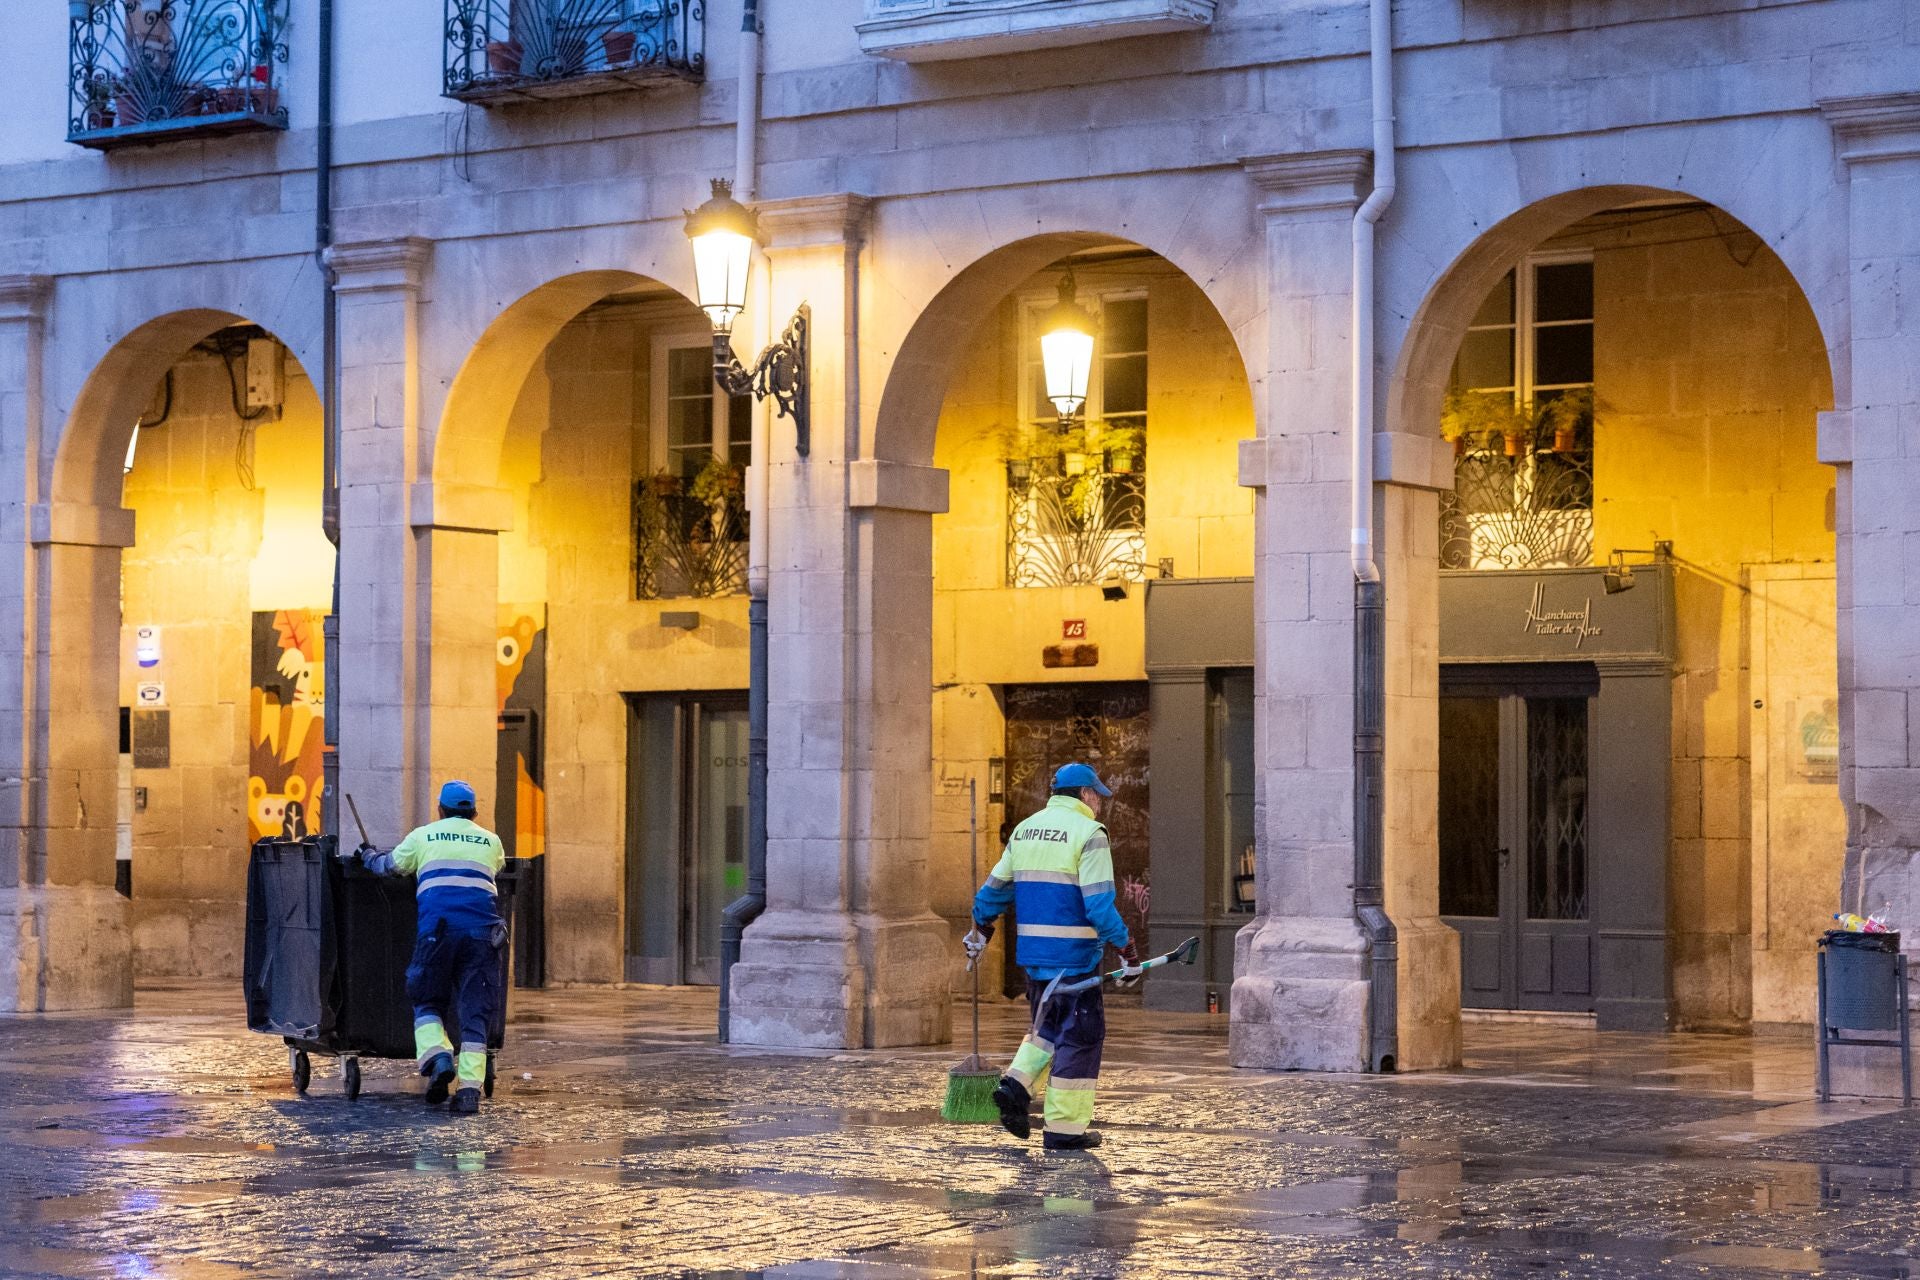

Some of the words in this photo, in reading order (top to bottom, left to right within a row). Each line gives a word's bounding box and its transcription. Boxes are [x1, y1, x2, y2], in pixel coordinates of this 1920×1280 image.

[1066, 623, 1083, 636] 15
[1535, 623, 1562, 634] Taller
[1562, 623, 1575, 634] de
[1576, 597, 1601, 649] Arte
[427, 832, 491, 847] LIMPIEZA
[1014, 829, 1068, 843] LIMPIEZA
